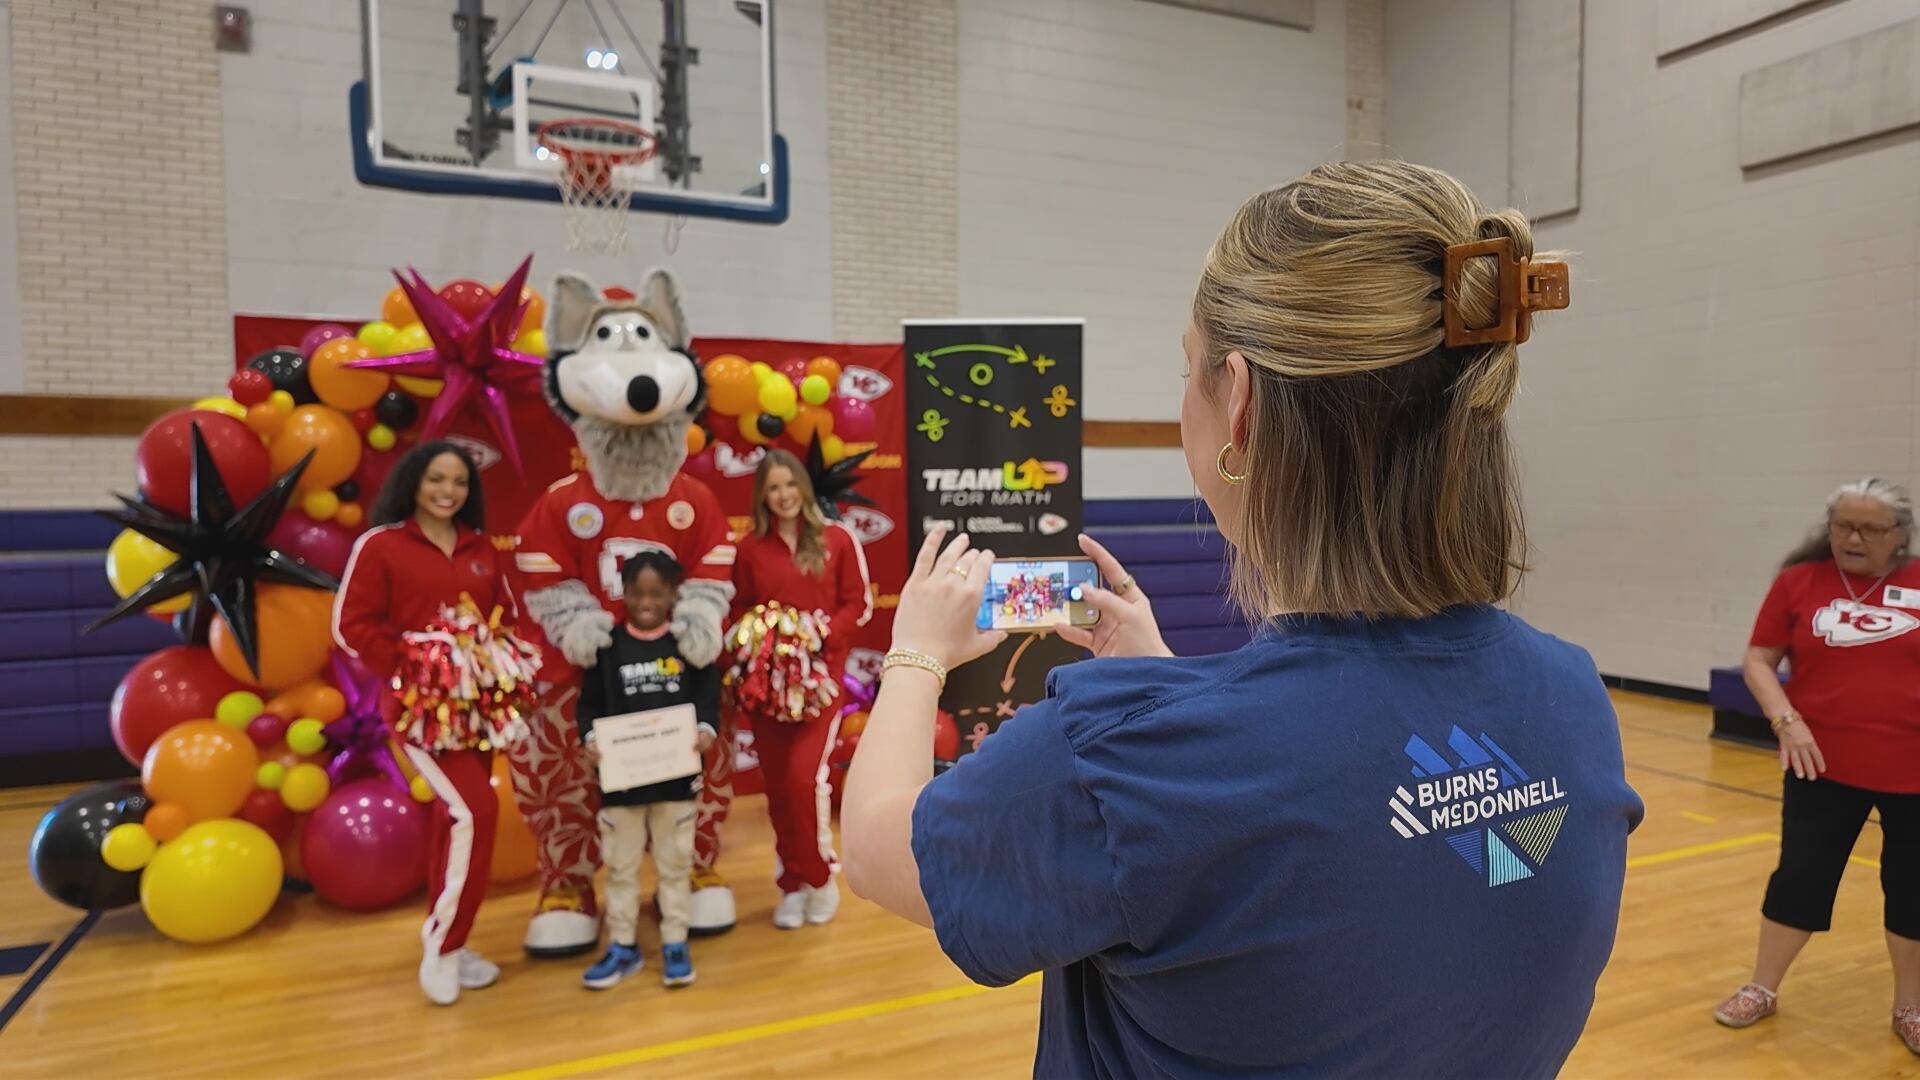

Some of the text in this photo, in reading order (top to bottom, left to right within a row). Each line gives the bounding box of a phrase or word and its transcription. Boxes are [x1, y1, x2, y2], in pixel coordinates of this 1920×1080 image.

[940, 490, 1052, 507] FOR MATH
[1417, 767, 1499, 808] BURNS
